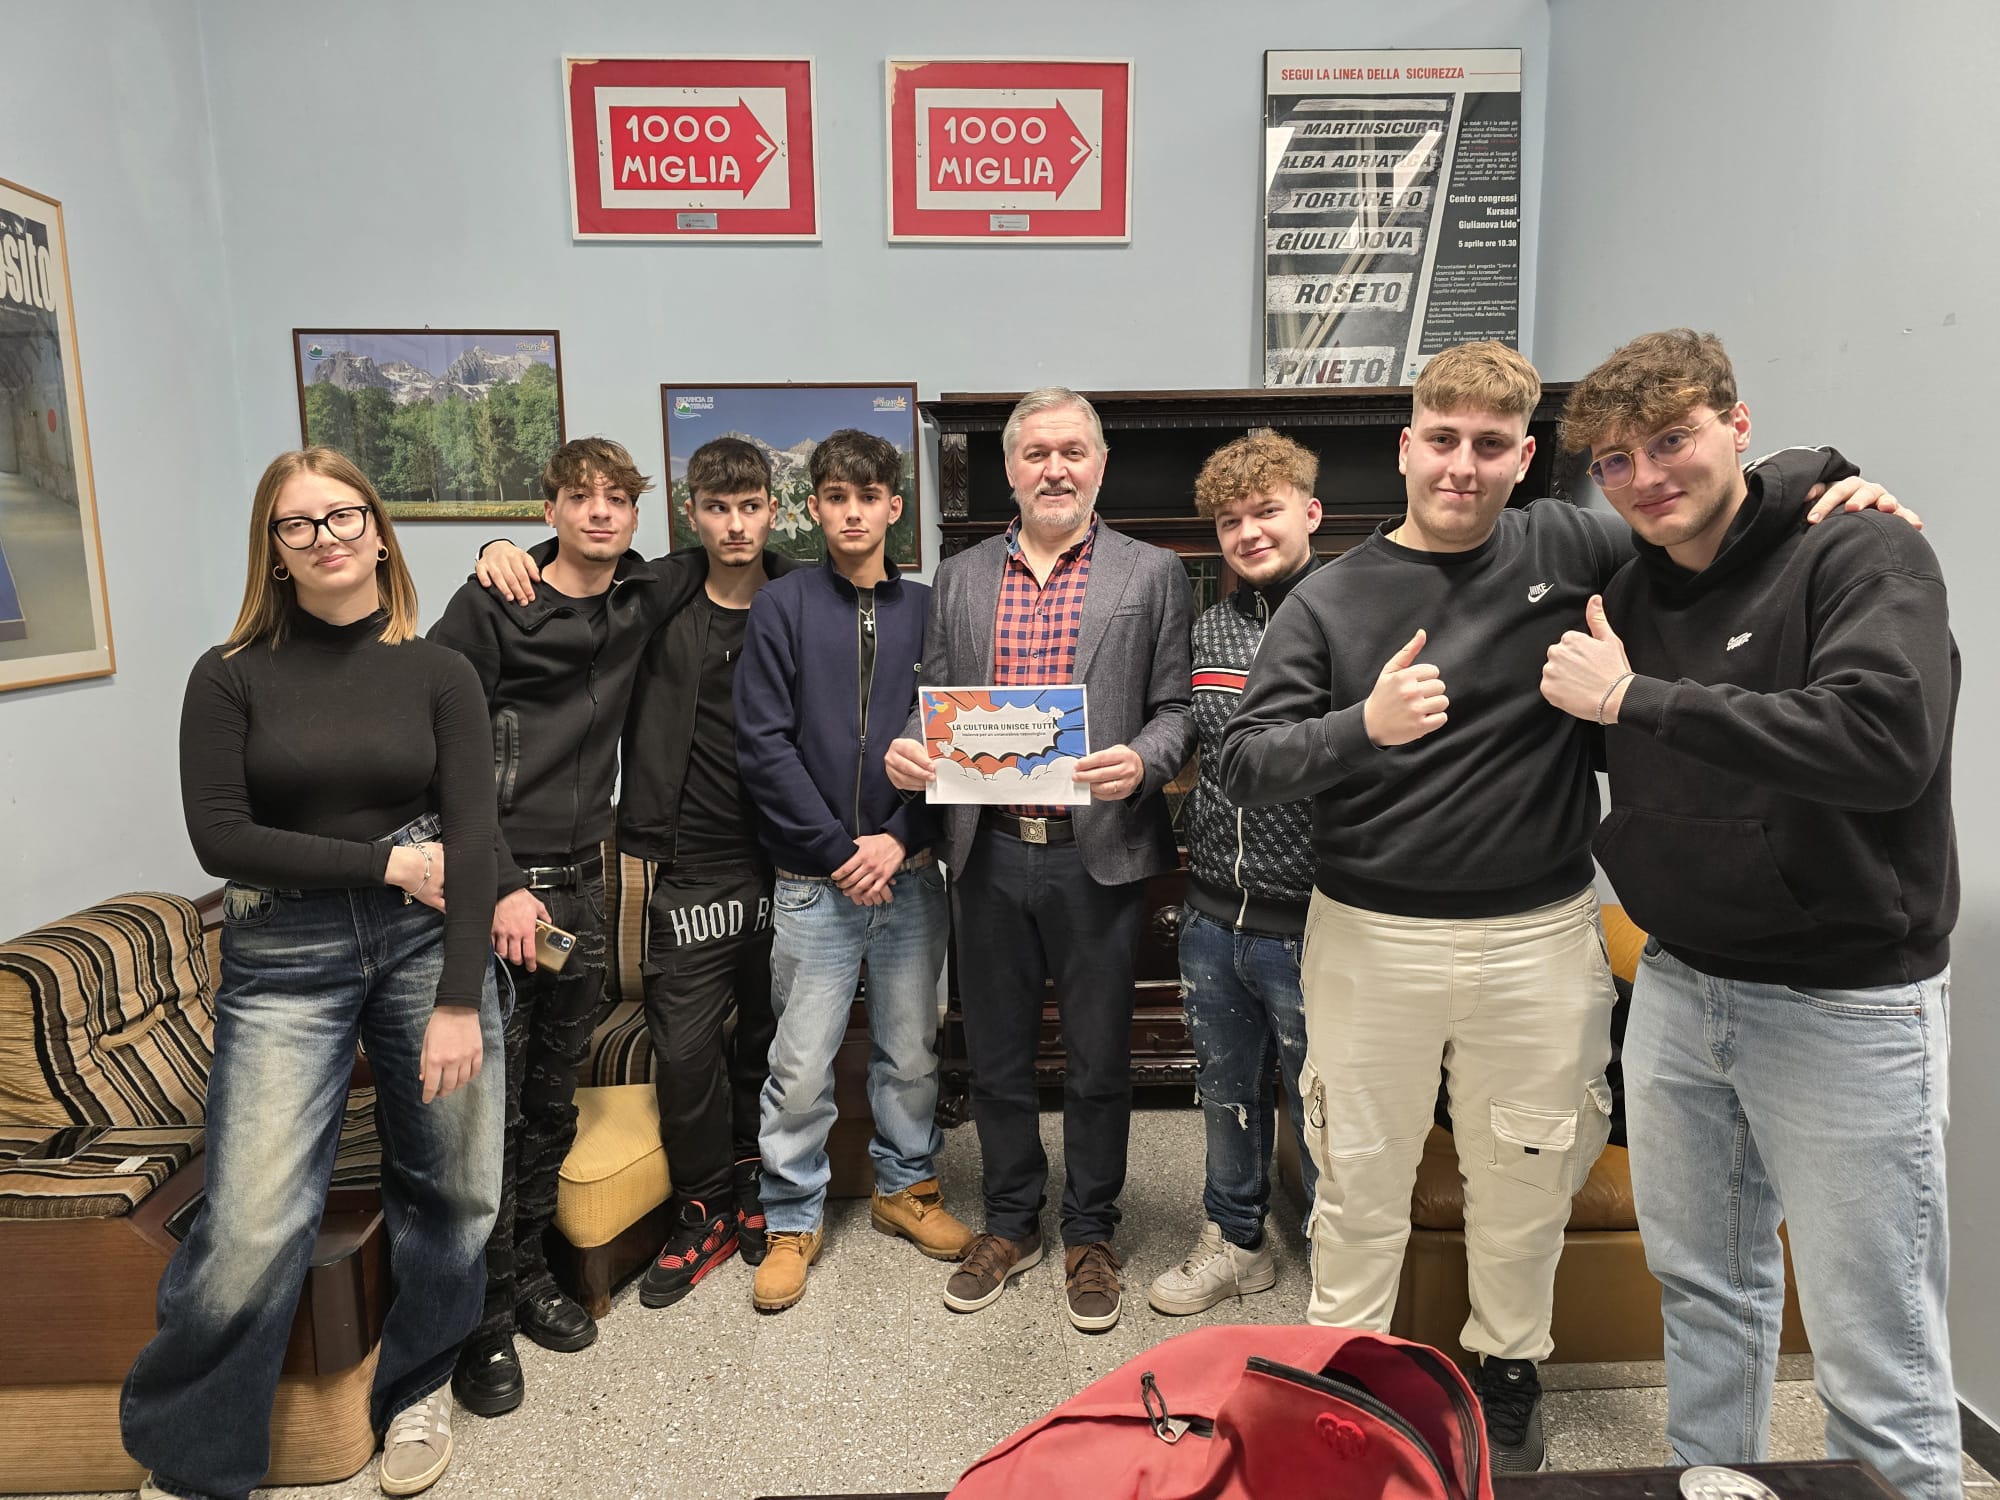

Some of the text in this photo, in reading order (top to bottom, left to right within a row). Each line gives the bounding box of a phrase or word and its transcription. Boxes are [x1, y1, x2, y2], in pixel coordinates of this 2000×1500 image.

[1281, 67, 1464, 80] SEGUI LA LINEA DELLA SICUREZZA
[626, 115, 731, 143] 1000
[944, 116, 1046, 144] 1000
[621, 155, 741, 183] MIGLIA
[1279, 155, 1326, 169] ALBA
[937, 157, 1053, 185] MIGLIA
[1449, 193, 1517, 204] Centro congressi
[1486, 207, 1517, 215] Kursaal
[1458, 220, 1517, 229] Giulianova Lido
[1458, 240, 1463, 248] 5
[1464, 240, 1484, 248] aprile
[1295, 281, 1401, 304] ROSETO
[1276, 358, 1386, 384] PINETO
[1529, 582, 1546, 597] NIKE
[963, 723, 999, 731] CULTURA
[1032, 722, 1055, 730] TUTTI
[668, 897, 775, 946] HOOD R
